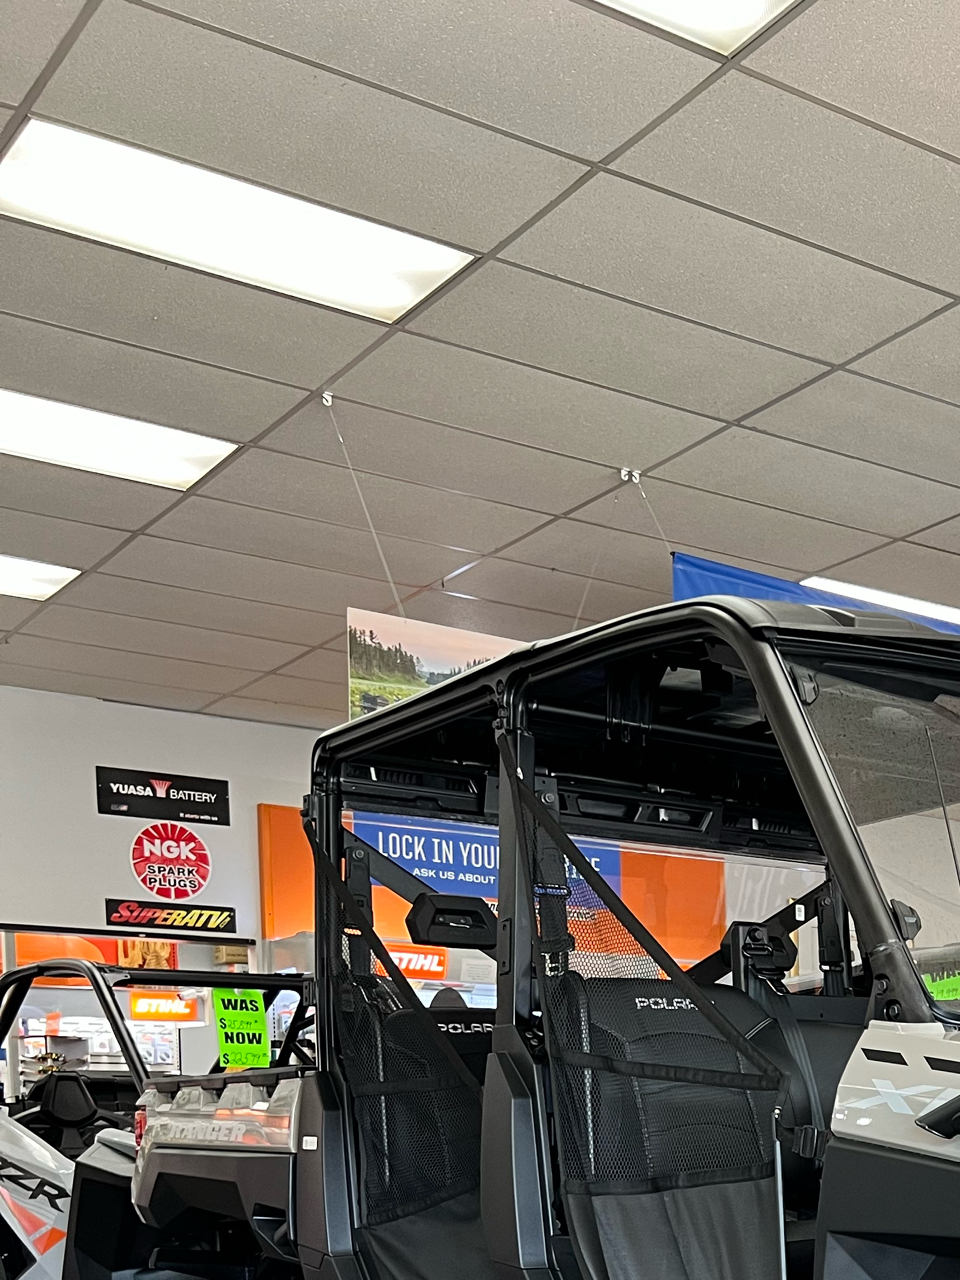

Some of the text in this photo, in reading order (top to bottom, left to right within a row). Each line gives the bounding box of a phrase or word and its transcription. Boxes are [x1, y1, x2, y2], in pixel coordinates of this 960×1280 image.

[110, 782, 217, 803] YUASA BATTERY
[143, 839, 197, 861] NGK
[378, 832, 499, 870] LOCK IN YOU
[147, 865, 196, 877] SPARK
[413, 867, 496, 885] ASK US ABOUT
[148, 877, 198, 889] PLUGS
[135, 998, 191, 1013] STIHL
[221, 998, 260, 1012] WAS
[635, 997, 700, 1011] POLAR
[224, 1032, 263, 1045] NOW
[169, 1123, 247, 1142] RANGER
